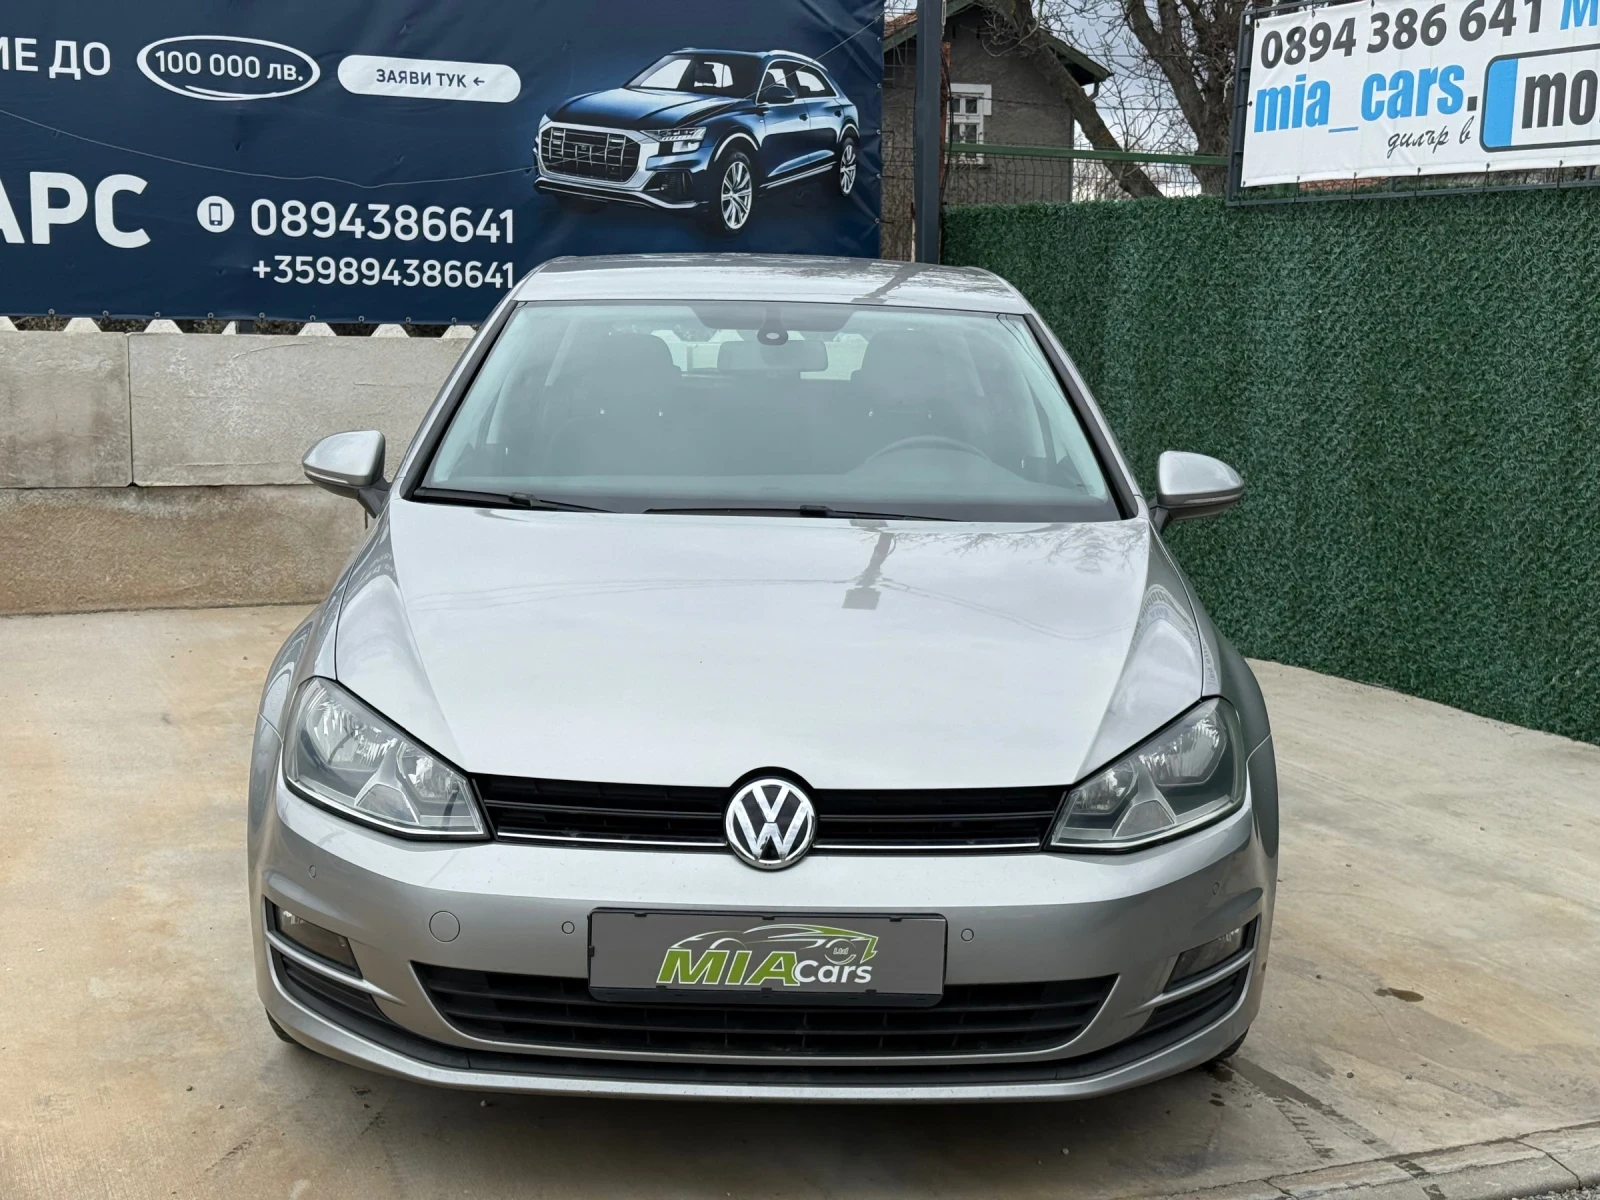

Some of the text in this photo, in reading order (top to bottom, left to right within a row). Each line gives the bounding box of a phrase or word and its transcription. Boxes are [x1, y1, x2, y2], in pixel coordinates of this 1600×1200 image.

[1260, 18, 1356, 69] 0894
[1366, 3, 1447, 53] 386
[1459, 0, 1542, 42] 641
[49, 39, 111, 80] ДО
[155, 50, 201, 75] 100
[209, 53, 261, 80] 000
[267, 64, 304, 82] лв.
[375, 68, 468, 89] ЗАЯВИ ТУК
[1386, 125, 1450, 159] дилър
[250, 198, 515, 244] 0894386641
[252, 255, 515, 289] +359894386641
